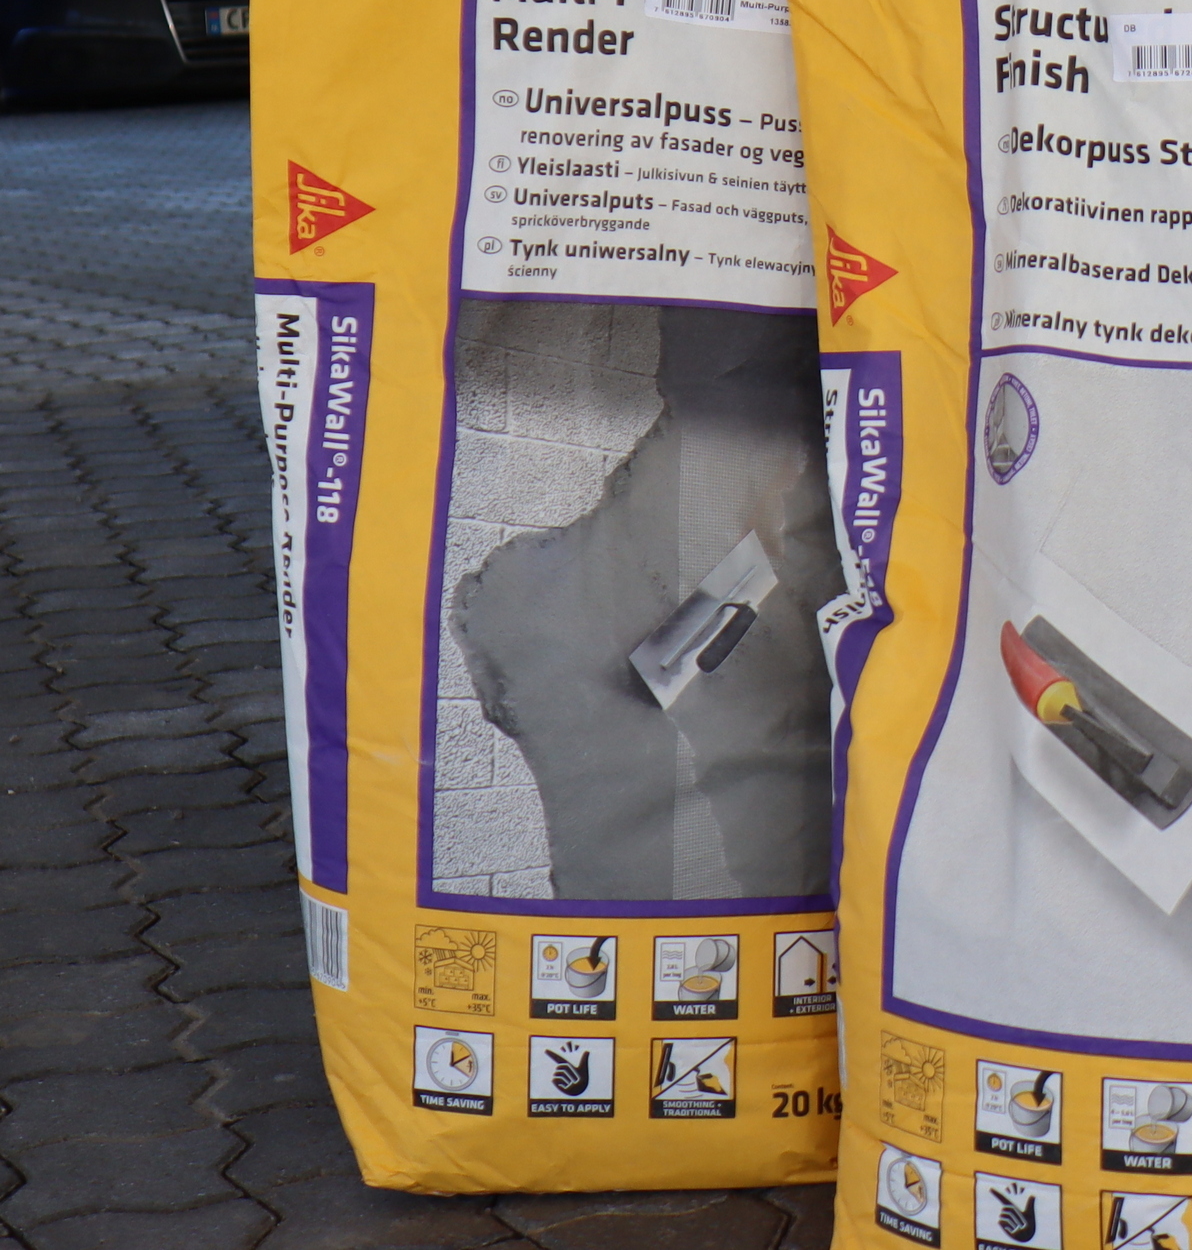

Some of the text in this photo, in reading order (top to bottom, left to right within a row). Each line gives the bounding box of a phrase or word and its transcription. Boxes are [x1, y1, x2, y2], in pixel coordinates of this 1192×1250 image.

[492, 17, 635, 56] Render
[994, 4, 1109, 44] Structu
[1123, 24, 1136, 32] DB
[996, 50, 1090, 94] Finish
[525, 87, 732, 128] Universalpuss
[520, 129, 805, 168] renovering av fasader og veg
[1011, 123, 1150, 168] Dekorpuss
[517, 156, 807, 196] Yleislaasti Julkisivun & seinien täytt
[296, 172, 346, 240] Sika
[514, 187, 808, 226] Universalputs Fasad och väggputs,
[1010, 192, 1144, 223] Dekoratiivinen
[511, 215, 650, 232] spricköverbryggande
[509, 238, 559, 261] Tynk
[565, 241, 690, 267] uniwersalny
[708, 252, 741, 268] Tynk
[1005, 249, 1150, 283] Mineralbaserad
[507, 264, 557, 280] ścienny
[829, 237, 868, 308] Sika
[1003, 309, 1088, 339] Mineralny
[1093, 319, 1143, 343] tynk
[547, 1003, 598, 1015] POT LIFE
[673, 1004, 716, 1015] WATER
[793, 994, 832, 1005] INTERIOR
[795, 1003, 836, 1014] EXTERIOR
[420, 1094, 484, 1110] TIME SAVING
[531, 1103, 611, 1113] EASY TO APPLY
[663, 1109, 722, 1117] TRADITIONAL
[772, 1091, 810, 1119] 20
[991, 1137, 1043, 1157] POT LIFE
[1124, 1155, 1172, 1169] WATER
[879, 1212, 933, 1242] TIME SAVING
